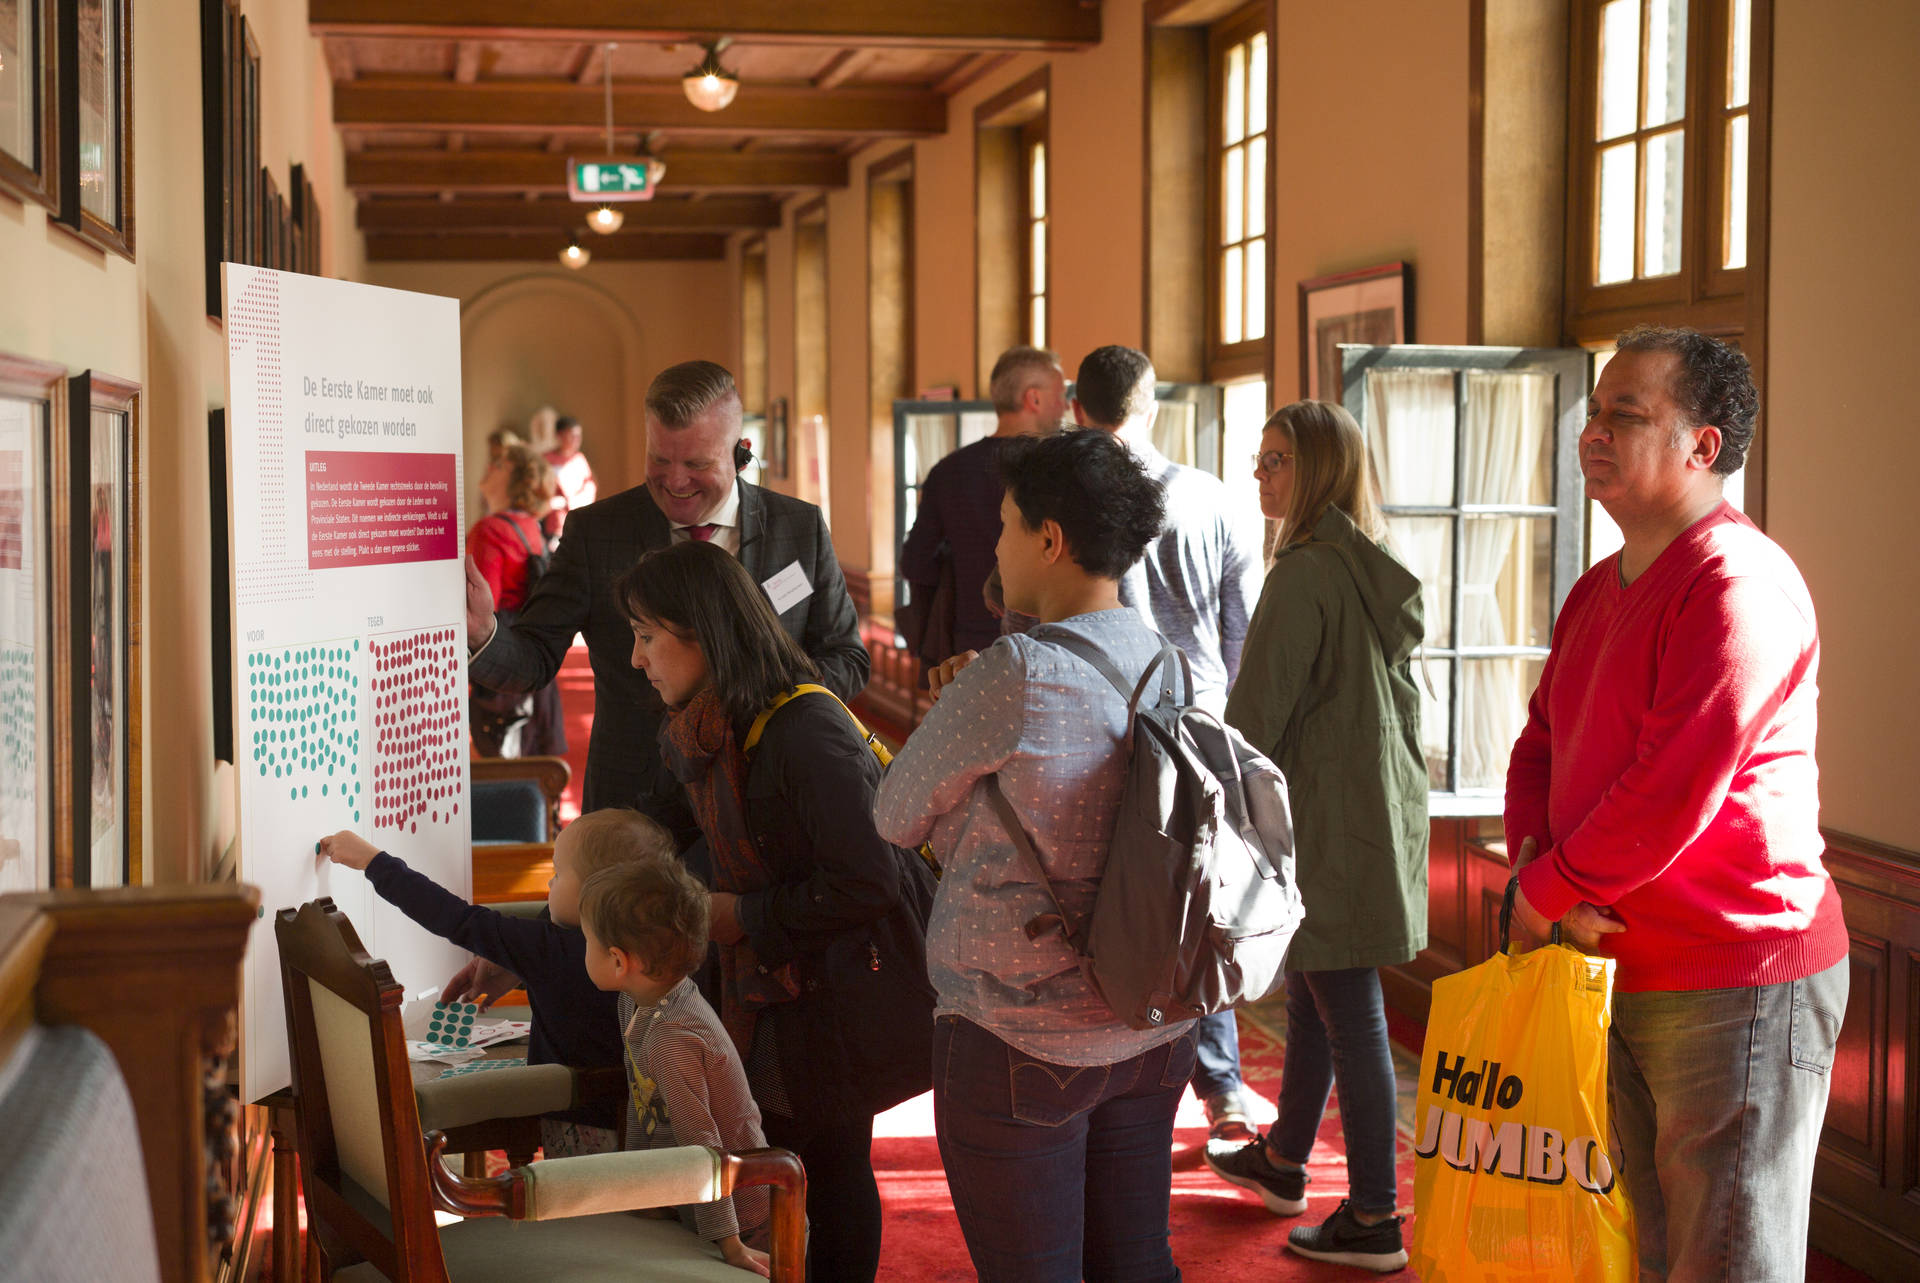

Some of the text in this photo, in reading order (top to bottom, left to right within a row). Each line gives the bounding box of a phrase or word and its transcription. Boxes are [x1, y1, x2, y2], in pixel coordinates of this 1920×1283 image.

[303, 375, 434, 405] De Eerste Kamer moet ook
[304, 411, 417, 440] direct gekozen worden
[309, 461, 327, 473] UITLEG
[316, 480, 338, 491] Nederland
[340, 481, 352, 491] wordt
[353, 480, 359, 491] de
[360, 480, 375, 491] Tweede
[376, 480, 389, 491] Kamer
[414, 480, 423, 491] door
[424, 480, 430, 490] de
[430, 480, 448, 492] bevolking
[331, 497, 338, 508] De
[338, 497, 352, 508] Eerste
[352, 497, 366, 507] Kamer
[366, 497, 379, 507] wordt
[379, 497, 396, 509] gekozen
[397, 496, 406, 506] door
[407, 496, 412, 506] de
[413, 496, 424, 506] Leden
[432, 496, 438, 505] de
[311, 514, 335, 525] Provinciale
[359, 514, 376, 523] noemen
[377, 514, 383, 522] we
[383, 512, 401, 522] indirecte
[427, 511, 437, 520] Vindt
[311, 530, 317, 541] de
[318, 530, 333, 541] Eerste
[333, 530, 348, 540] Kamer
[348, 530, 356, 540] ook
[357, 529, 370, 539] direct
[370, 528, 387, 541] gekozen
[388, 528, 399, 537] moet
[416, 526, 424, 536] Dan
[425, 526, 434, 536] bent
[324, 548, 333, 558] met
[333, 546, 340, 557] de
[358, 544, 369, 555] Plakt
[374, 545, 382, 554] dan
[383, 545, 391, 553] een
[391, 545, 405, 556] groene
[367, 615, 384, 628] TEGEN
[246, 629, 265, 643] VOOR
[1432, 1050, 1523, 1110] Hallo
[1415, 1104, 1616, 1195] JUMBO
